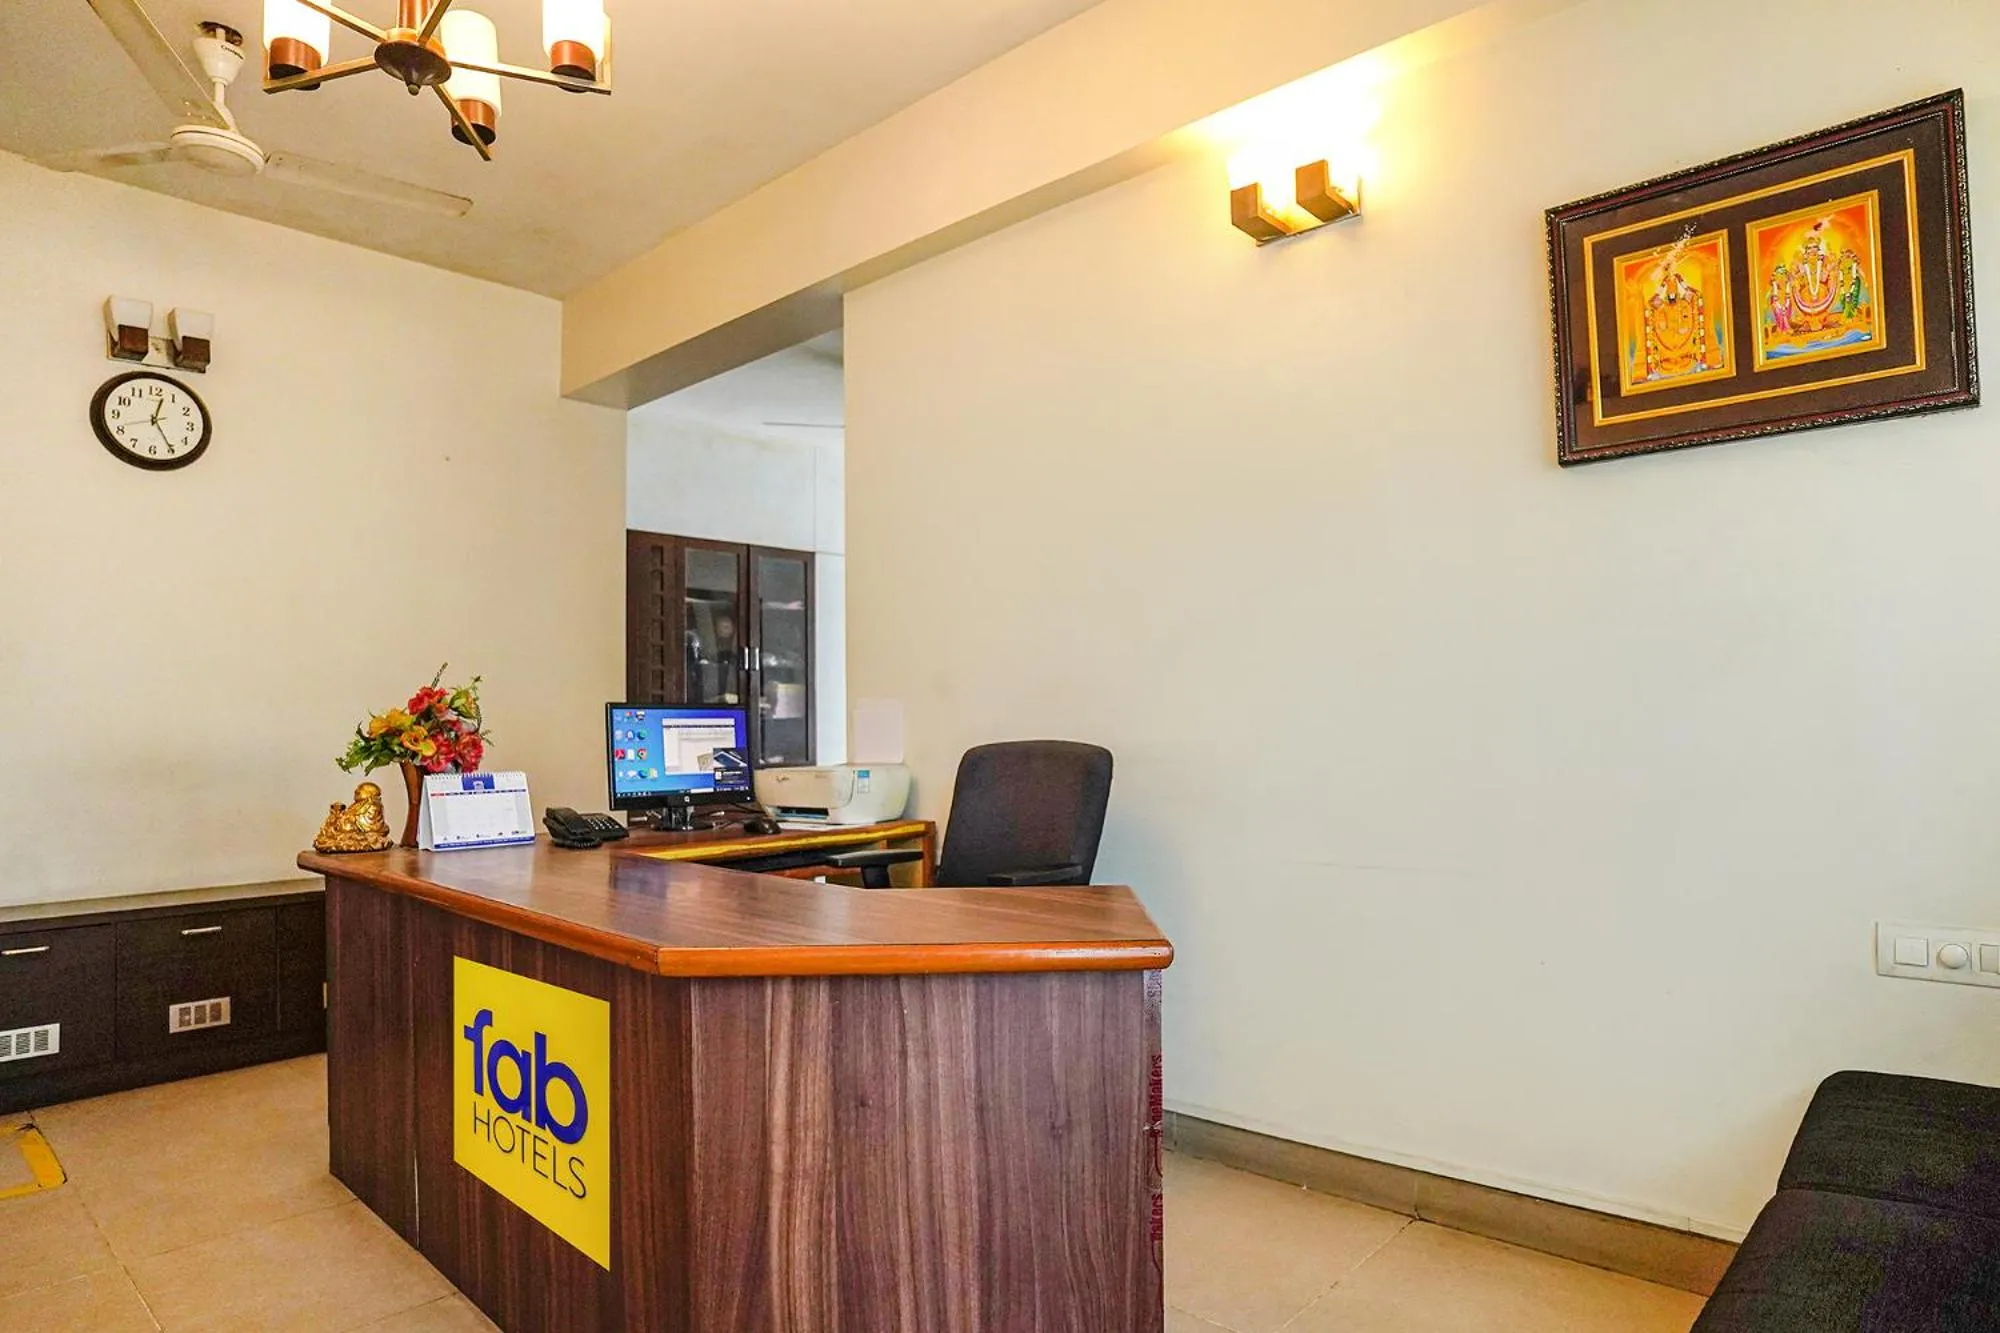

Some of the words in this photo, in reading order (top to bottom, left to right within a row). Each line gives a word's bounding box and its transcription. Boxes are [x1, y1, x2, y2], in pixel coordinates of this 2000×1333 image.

[131, 387, 143, 398] 11
[149, 386, 163, 396] 12
[118, 396, 131, 407] 10
[112, 409, 120, 419] 9
[182, 406, 190, 417] 2
[116, 425, 125, 435] 8
[186, 421, 194, 432] 3
[130, 438, 138, 448] 7
[181, 436, 188, 446] 4
[148, 445, 157, 455] 6
[167, 443, 175, 454] 5
[464, 1008, 589, 1146] fab
[473, 1101, 587, 1199] HOTELS
